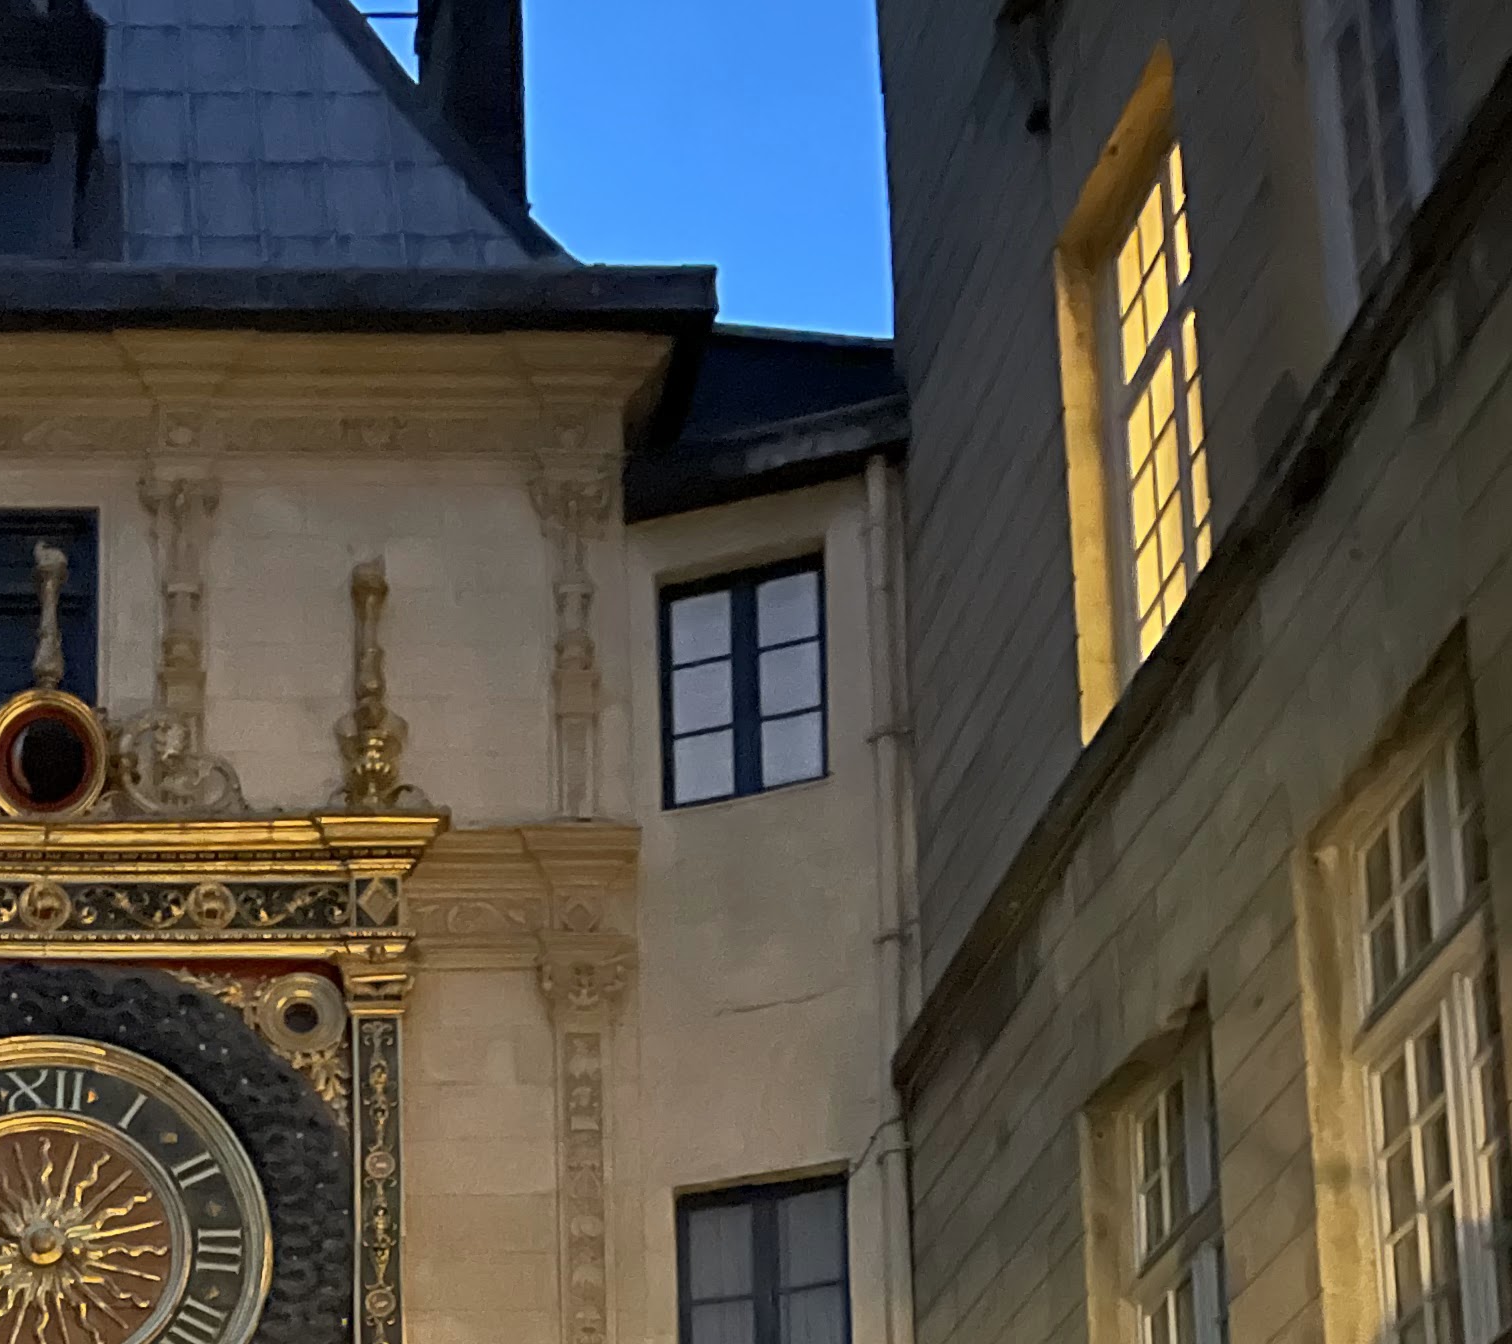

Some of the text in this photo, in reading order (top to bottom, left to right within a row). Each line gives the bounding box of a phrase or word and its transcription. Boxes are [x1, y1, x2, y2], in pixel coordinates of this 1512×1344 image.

[6, 1069, 84, 1111] XII
[118, 1094, 148, 1129] I
[171, 1151, 221, 1190] II
[195, 1228, 242, 1274] III
